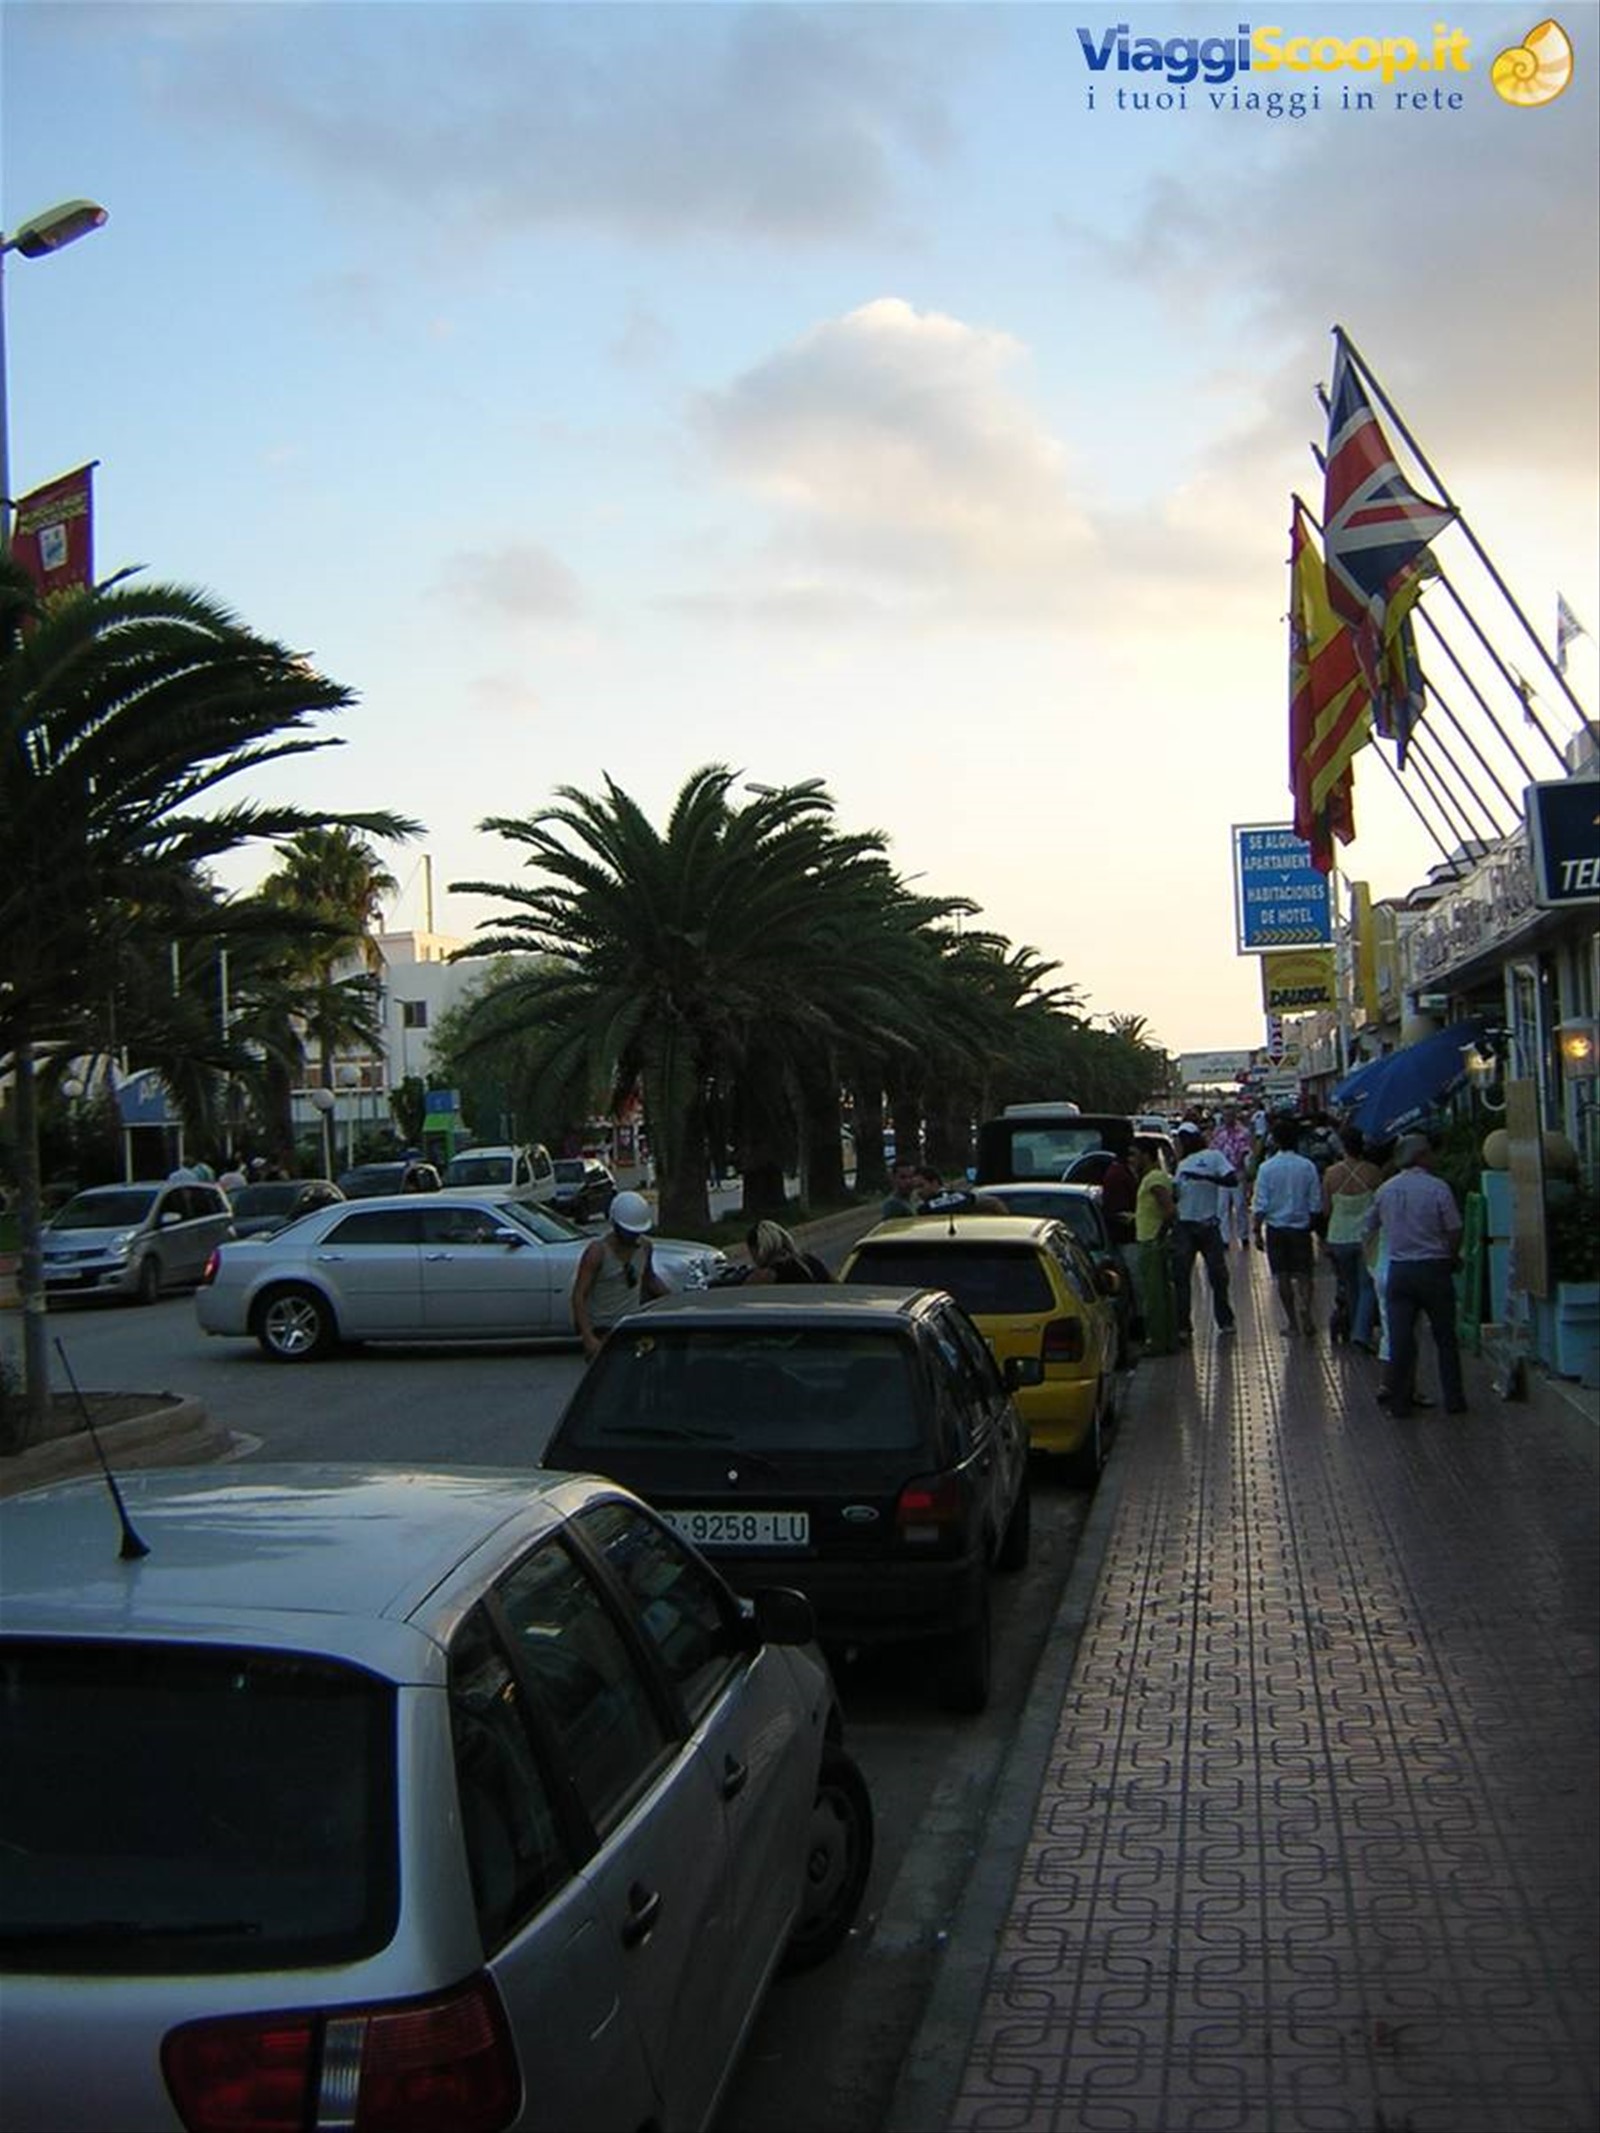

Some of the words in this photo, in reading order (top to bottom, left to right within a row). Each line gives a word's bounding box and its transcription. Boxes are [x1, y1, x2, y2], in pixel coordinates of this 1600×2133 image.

[1249, 835, 1263, 850] SE
[1247, 884, 1326, 903] HABITACIONES
[1260, 909, 1275, 925] DE
[1278, 907, 1314, 924] HOTEL
